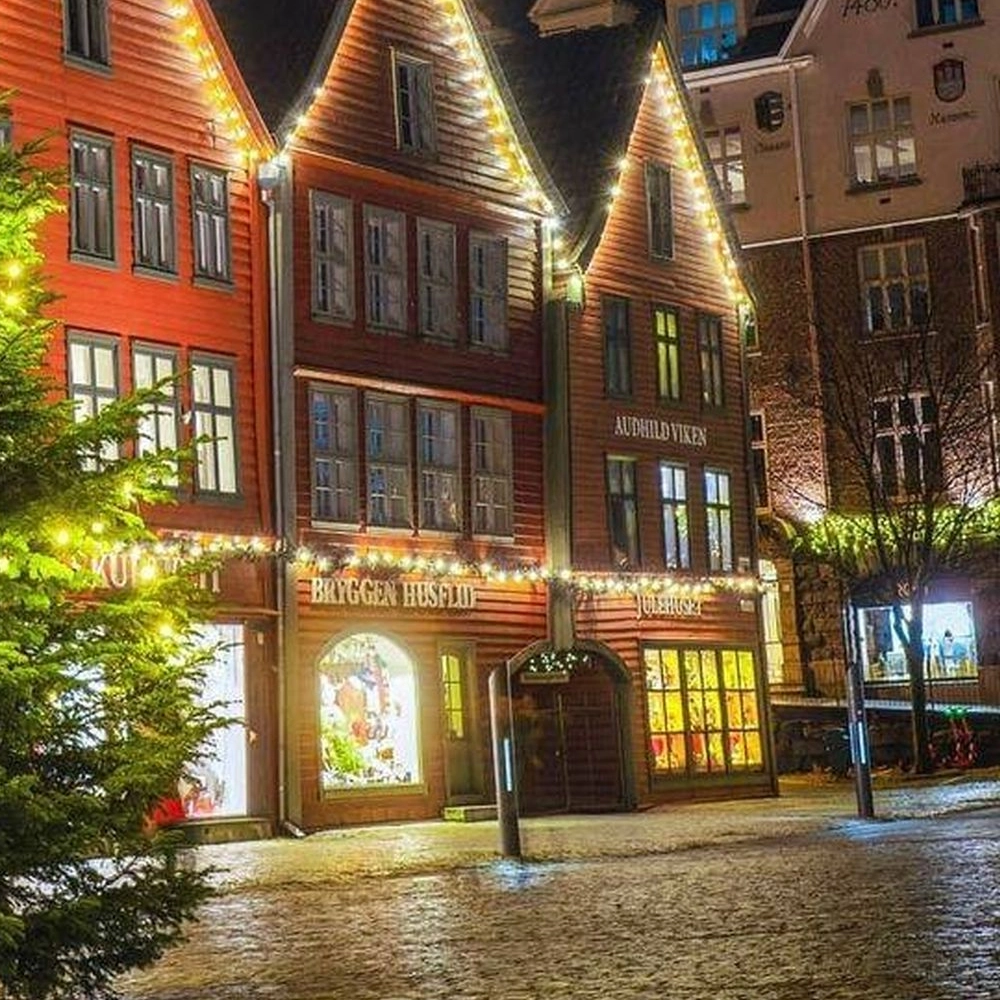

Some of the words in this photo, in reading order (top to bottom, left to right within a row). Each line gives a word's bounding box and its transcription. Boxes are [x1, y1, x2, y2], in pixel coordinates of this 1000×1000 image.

[614, 415, 669, 441] AUDHILD
[670, 422, 708, 447] VIKEN
[311, 576, 399, 607] BRYGGEN
[403, 580, 478, 610] HUSFLID
